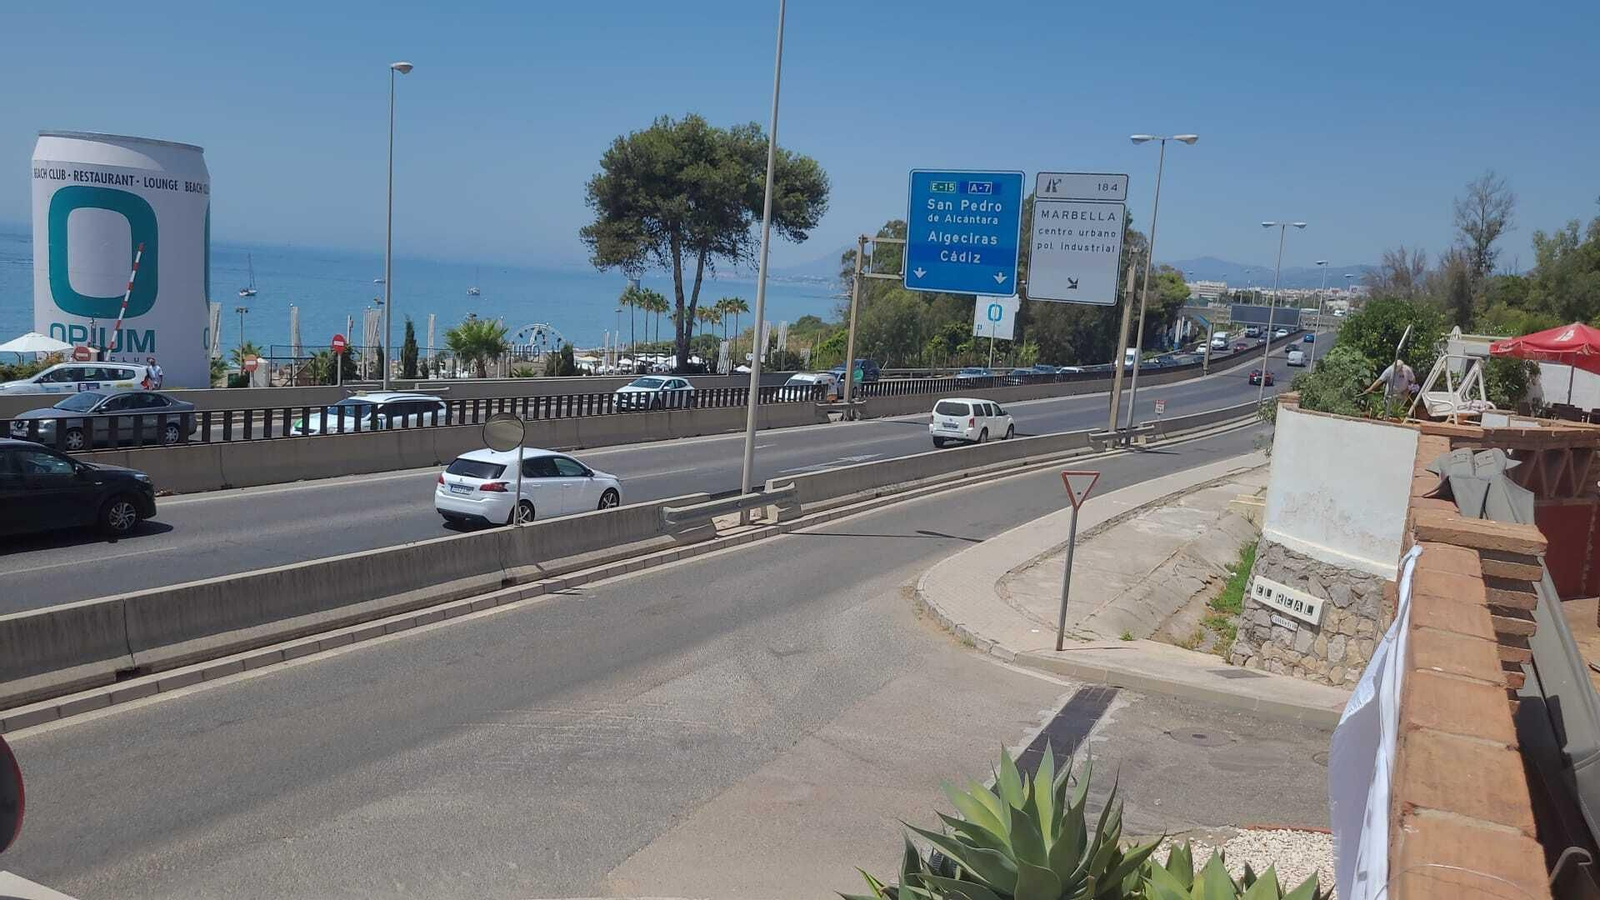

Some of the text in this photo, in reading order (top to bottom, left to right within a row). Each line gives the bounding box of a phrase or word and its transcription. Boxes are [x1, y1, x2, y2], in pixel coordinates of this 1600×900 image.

[49, 168, 66, 180] CLUB
[73, 170, 135, 187] RESTAURANT
[143, 176, 179, 191] LOUNGE
[931, 183, 991, 192] E-15 A-7
[1098, 183, 1118, 191] 184
[927, 199, 1002, 212] San Pedro
[927, 214, 940, 222] de
[1041, 210, 1116, 221] MARBELLA
[927, 230, 998, 246] Algeciras
[1038, 228, 1116, 238] centro urbano
[1060, 242, 1115, 253] industrial
[940, 250, 981, 264] Cádiz
[1256, 584, 1314, 616] EL REAL
